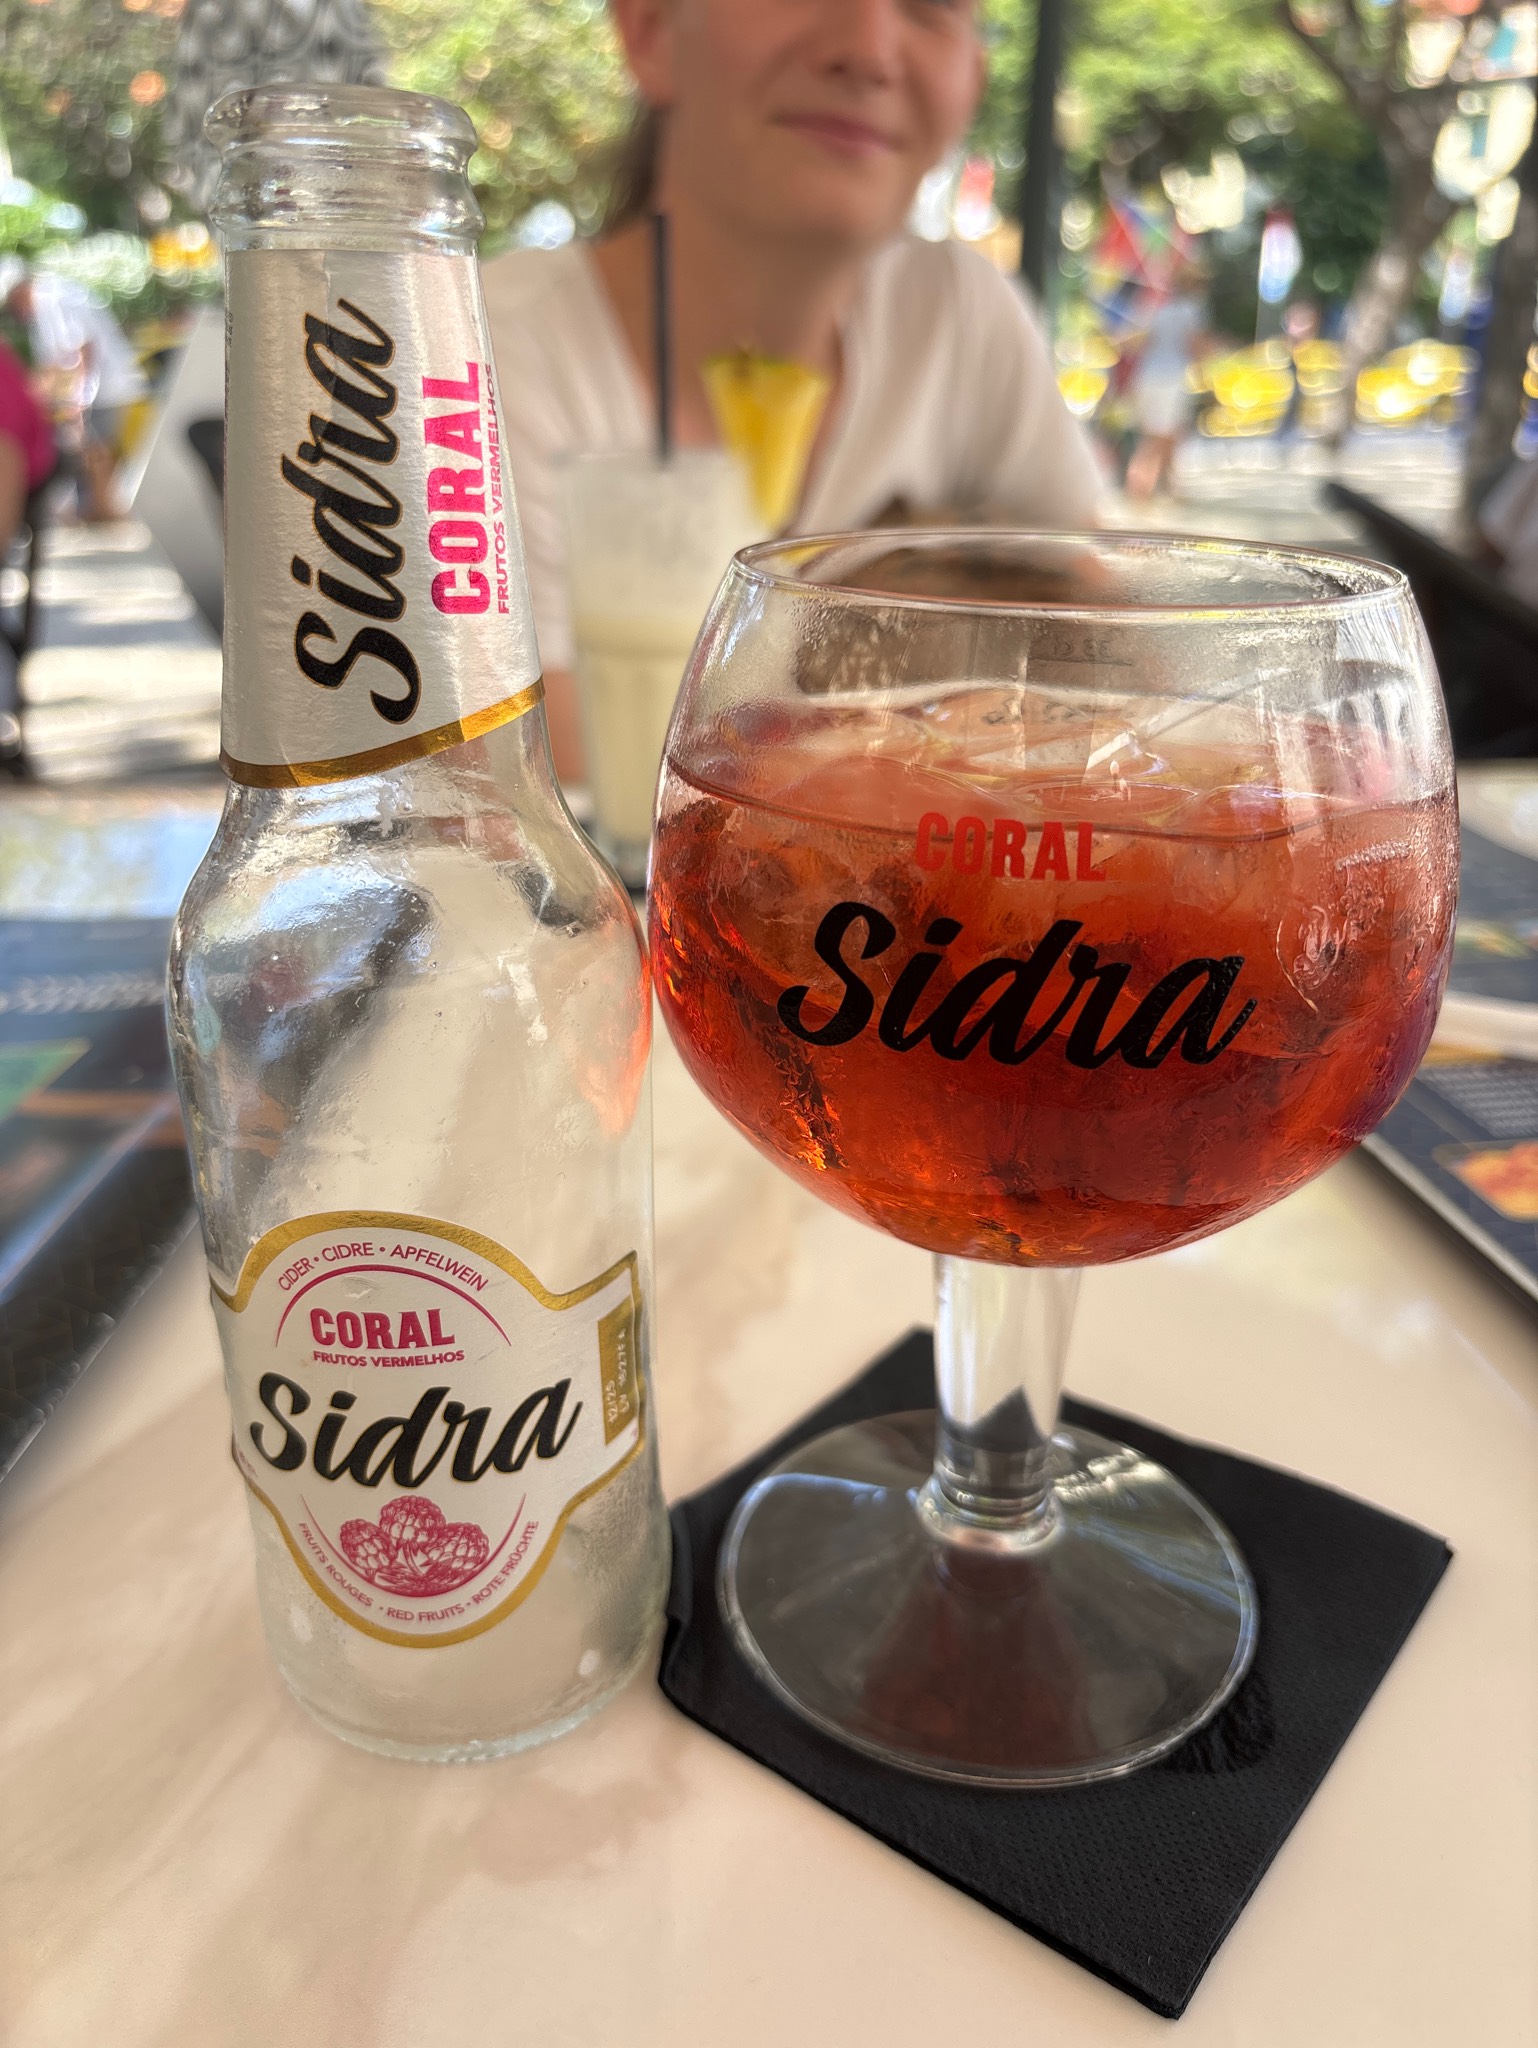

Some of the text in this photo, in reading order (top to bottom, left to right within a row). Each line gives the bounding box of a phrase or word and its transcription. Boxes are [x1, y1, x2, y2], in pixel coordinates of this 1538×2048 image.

[281, 298, 421, 725] Sidra
[422, 361, 491, 615] CORAL
[483, 363, 510, 614] FRUTOS VERMELHOS
[915, 811, 1107, 882] CORAL
[776, 900, 1259, 1070] Sidra
[278, 1242, 489, 1292] CIDER CIDRE APFELWEIN
[310, 1308, 456, 1349] CORAL
[313, 1350, 465, 1368] FRUTOS VERMELHOS
[250, 1372, 583, 1488] Sidra
[298, 1521, 540, 1622] FRUITS ROUGES RED FRUITS ROTE FRÜCHTE
